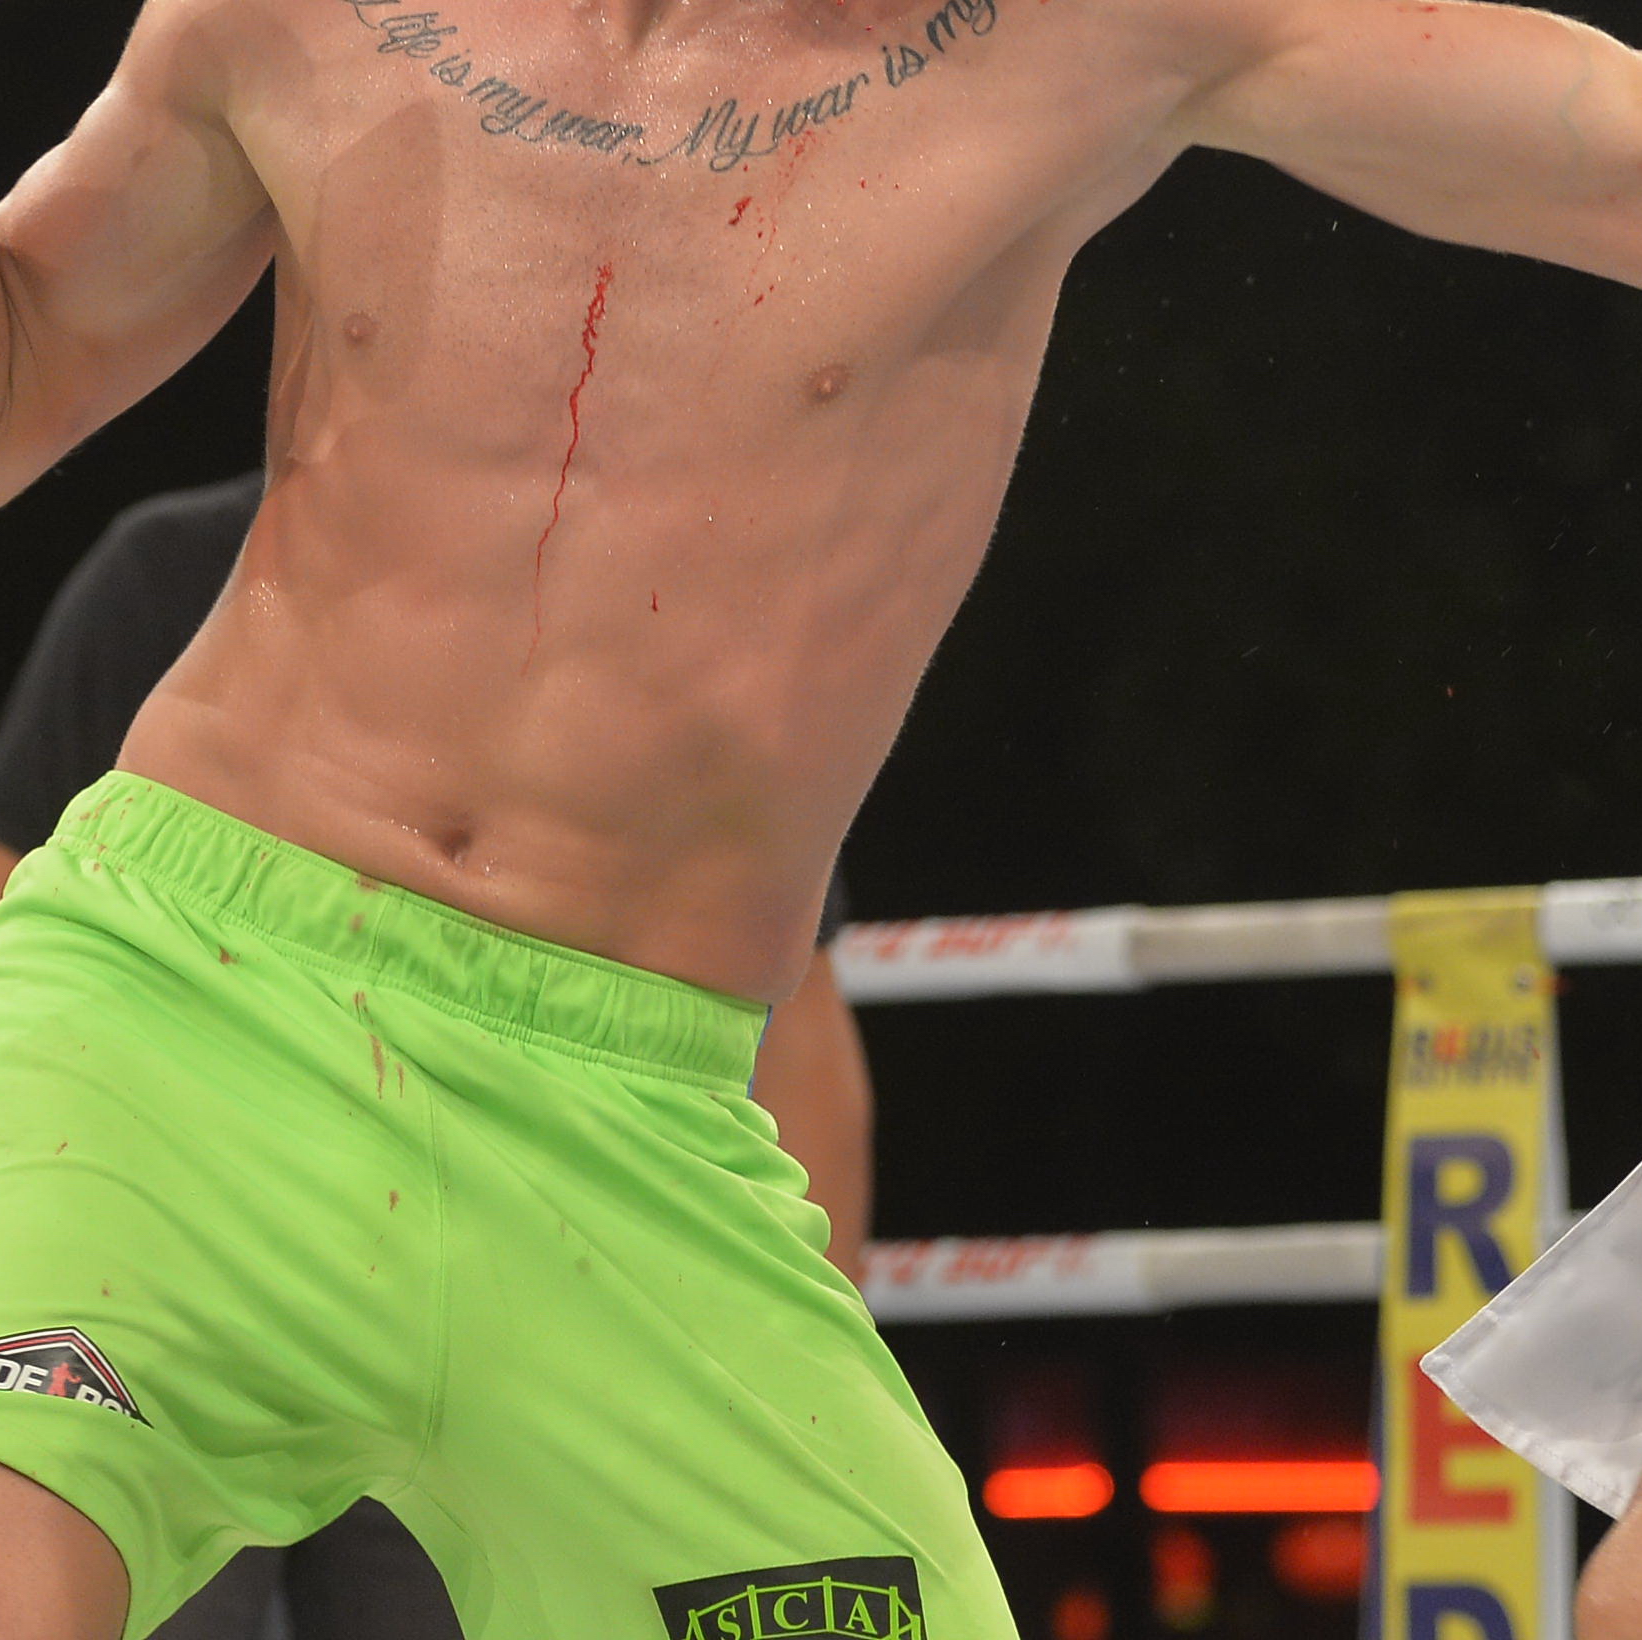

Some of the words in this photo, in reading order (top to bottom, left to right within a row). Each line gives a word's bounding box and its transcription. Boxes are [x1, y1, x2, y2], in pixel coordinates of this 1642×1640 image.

[377, 12, 458, 59] life
[430, 49, 472, 88] is
[467, 76, 548, 142] my
[637, 98, 772, 172] My
[767, 72, 870, 154] war
[882, 44, 929, 88] is
